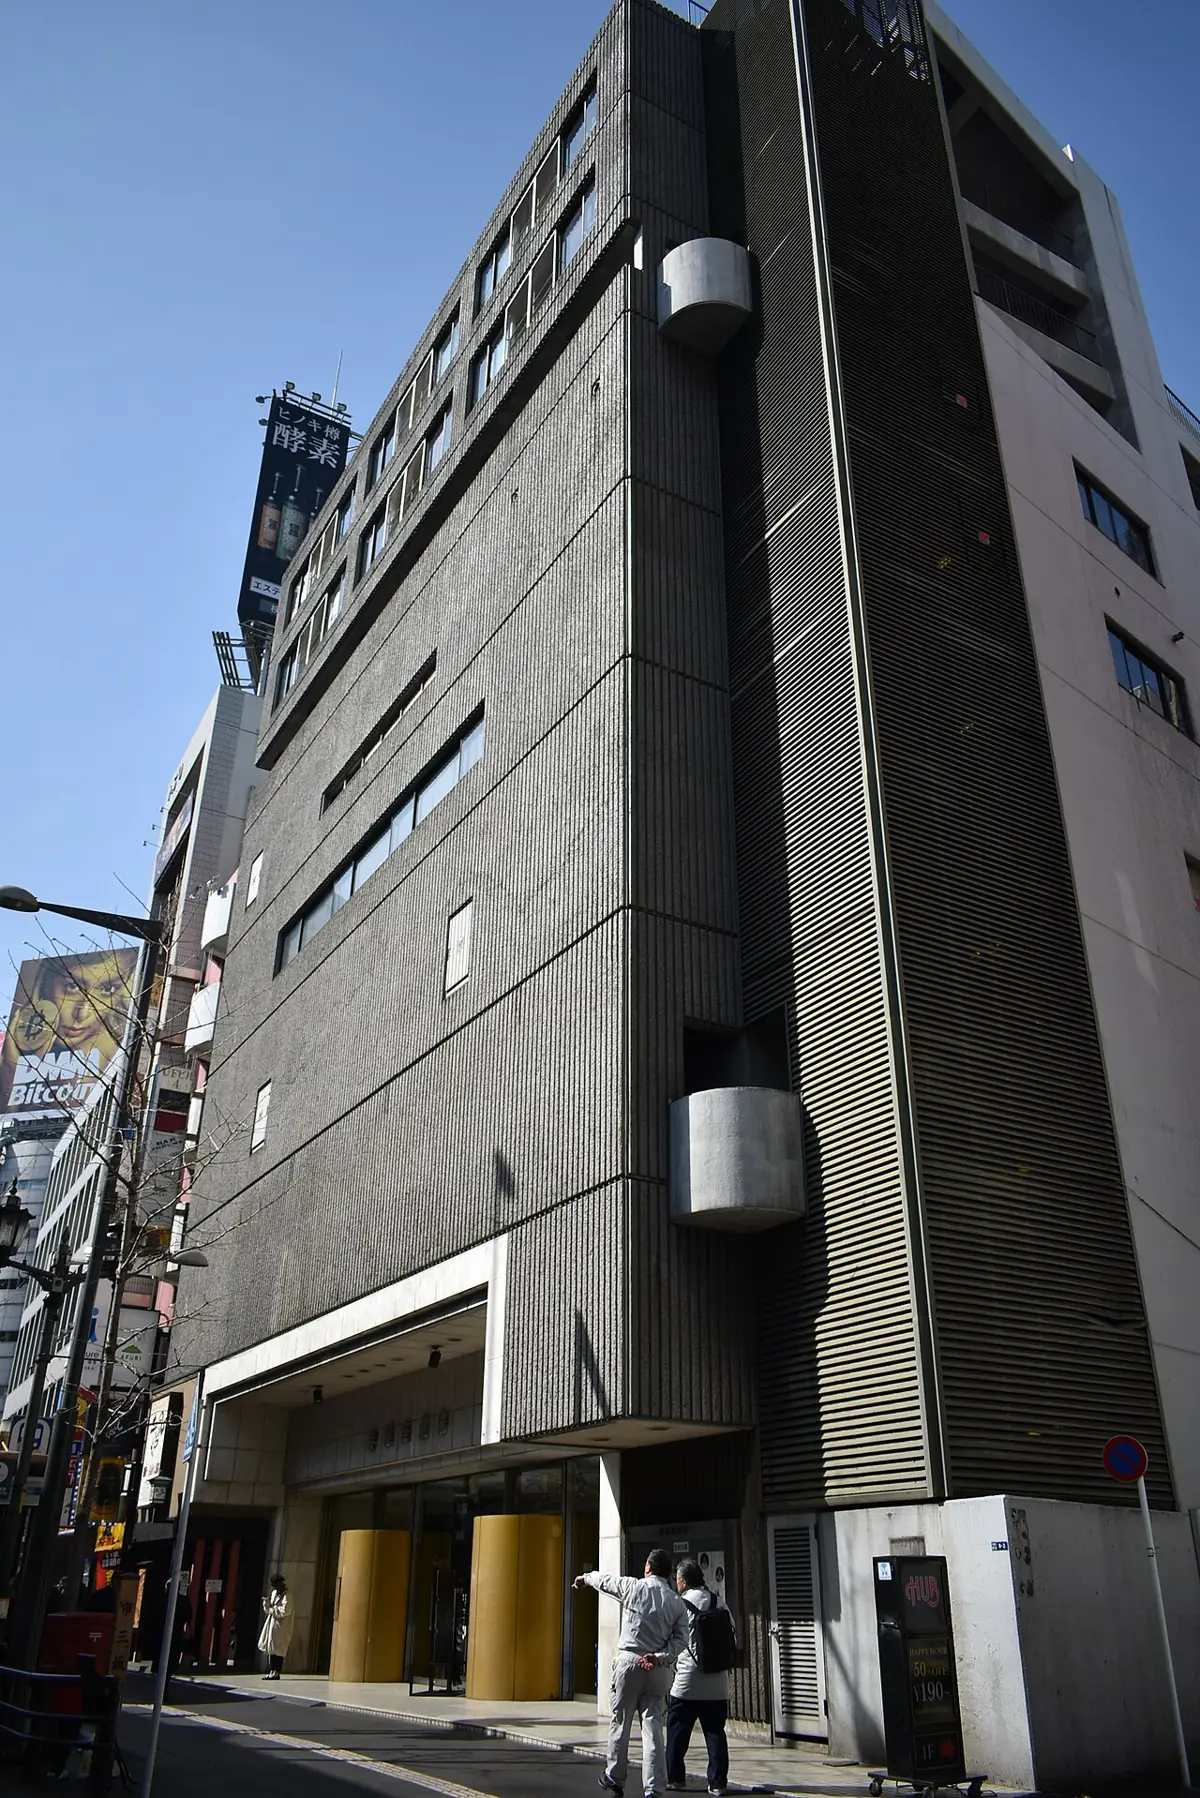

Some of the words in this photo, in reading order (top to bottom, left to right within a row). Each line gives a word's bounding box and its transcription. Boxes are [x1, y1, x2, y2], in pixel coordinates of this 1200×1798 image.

[272, 421, 340, 469] 酵素
[13, 1048, 100, 1085] DMM
[8, 1081, 95, 1106] Bitcoin
[905, 1575, 940, 1608] HUB
[111, 1600, 133, 1672] 市三坂
